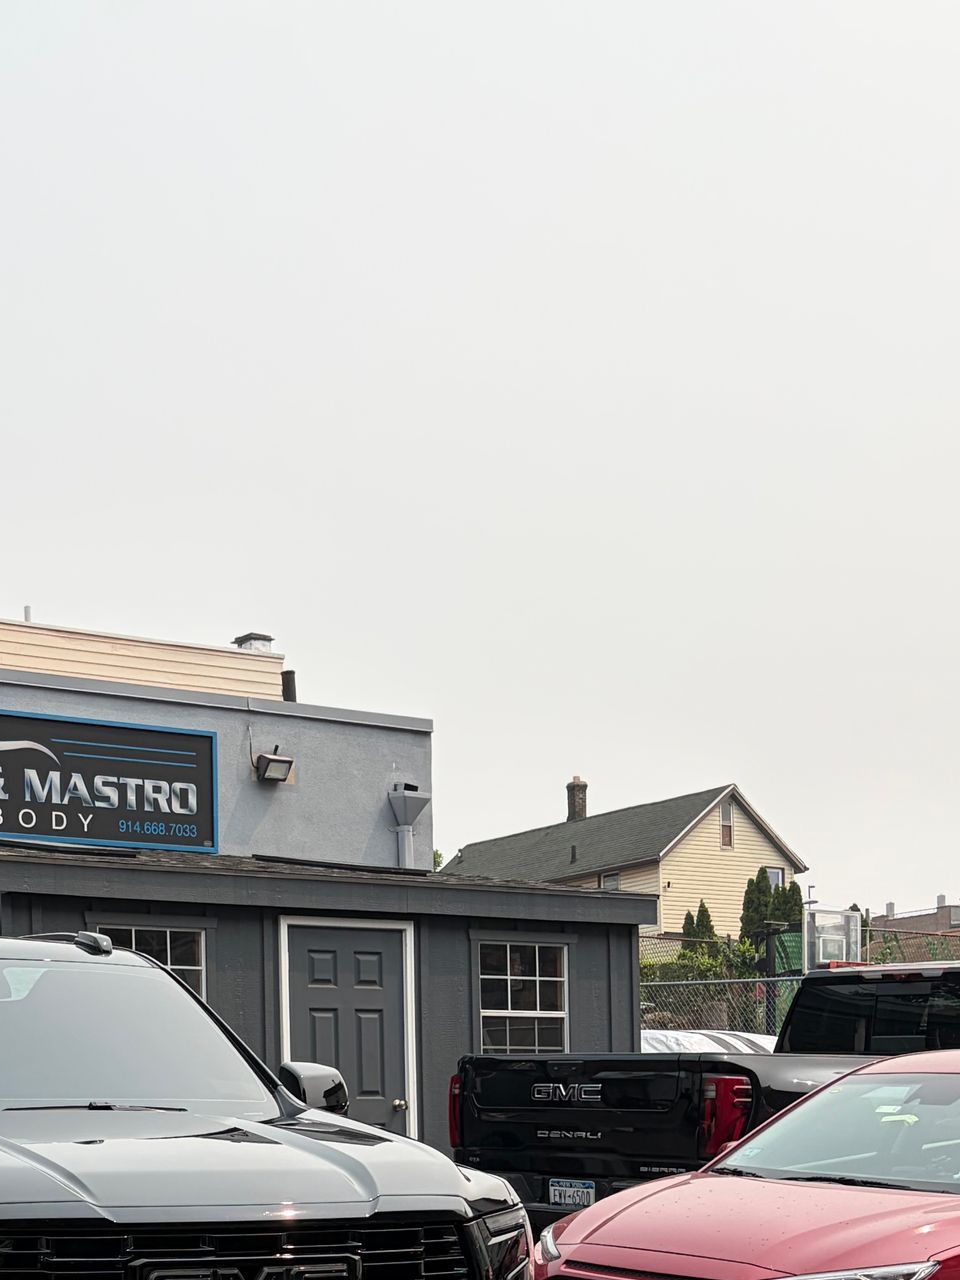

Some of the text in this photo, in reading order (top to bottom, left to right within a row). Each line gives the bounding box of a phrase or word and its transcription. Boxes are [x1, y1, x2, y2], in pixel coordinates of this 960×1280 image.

[24, 768, 198, 816] MASTRO
[119, 820, 198, 838] 914.668.7033
[531, 1083, 602, 1101] GMC
[537, 1130, 602, 1139] DENALI
